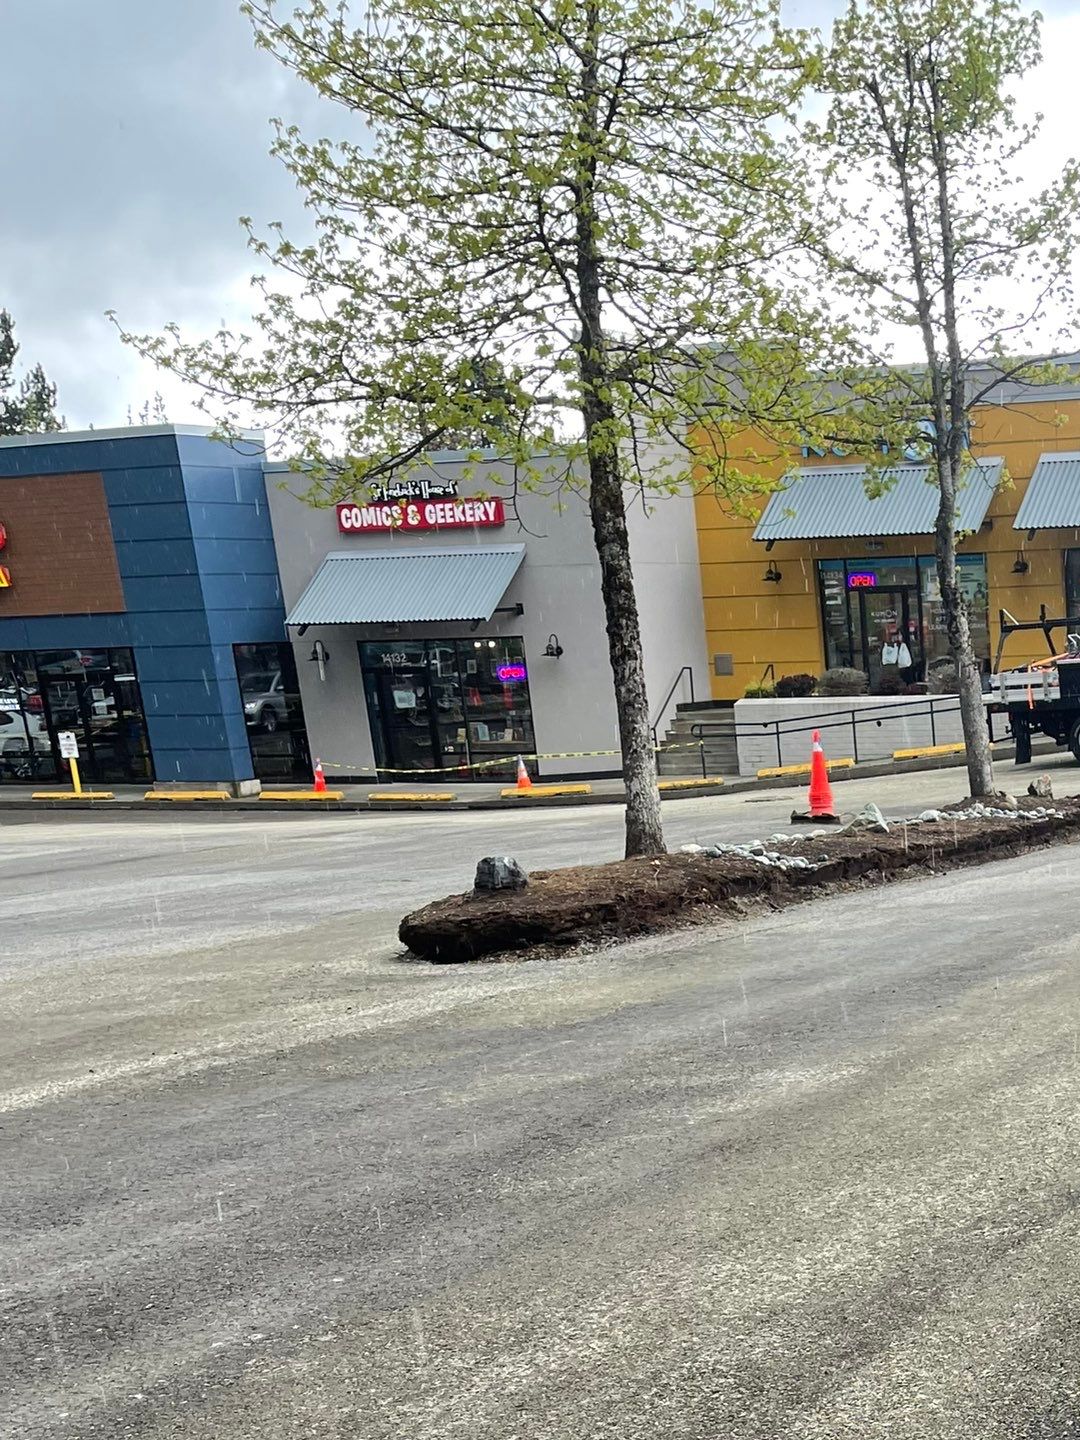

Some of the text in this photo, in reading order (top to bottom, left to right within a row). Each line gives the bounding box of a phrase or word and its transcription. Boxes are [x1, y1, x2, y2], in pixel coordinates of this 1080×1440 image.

[407, 503, 421, 526] &
[424, 501, 497, 525] GEEKERY
[849, 575, 875, 587] OPEN
[380, 652, 407, 664] 14132
